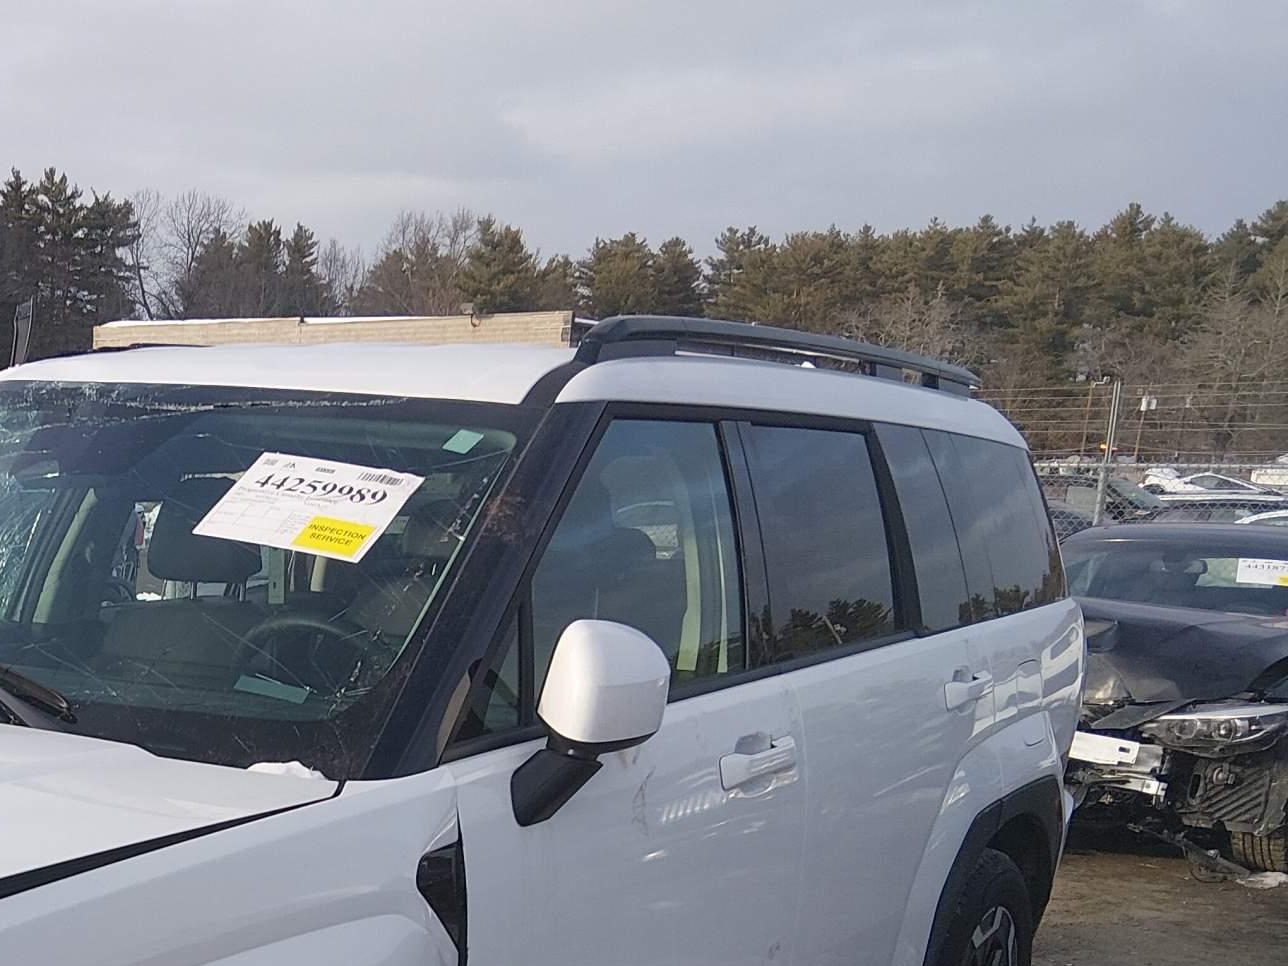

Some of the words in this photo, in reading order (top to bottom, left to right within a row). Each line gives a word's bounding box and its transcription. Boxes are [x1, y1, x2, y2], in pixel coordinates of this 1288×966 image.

[255, 473, 388, 505] 44259989
[308, 523, 367, 540] INSPECTION
[309, 533, 353, 546] SERVICE
